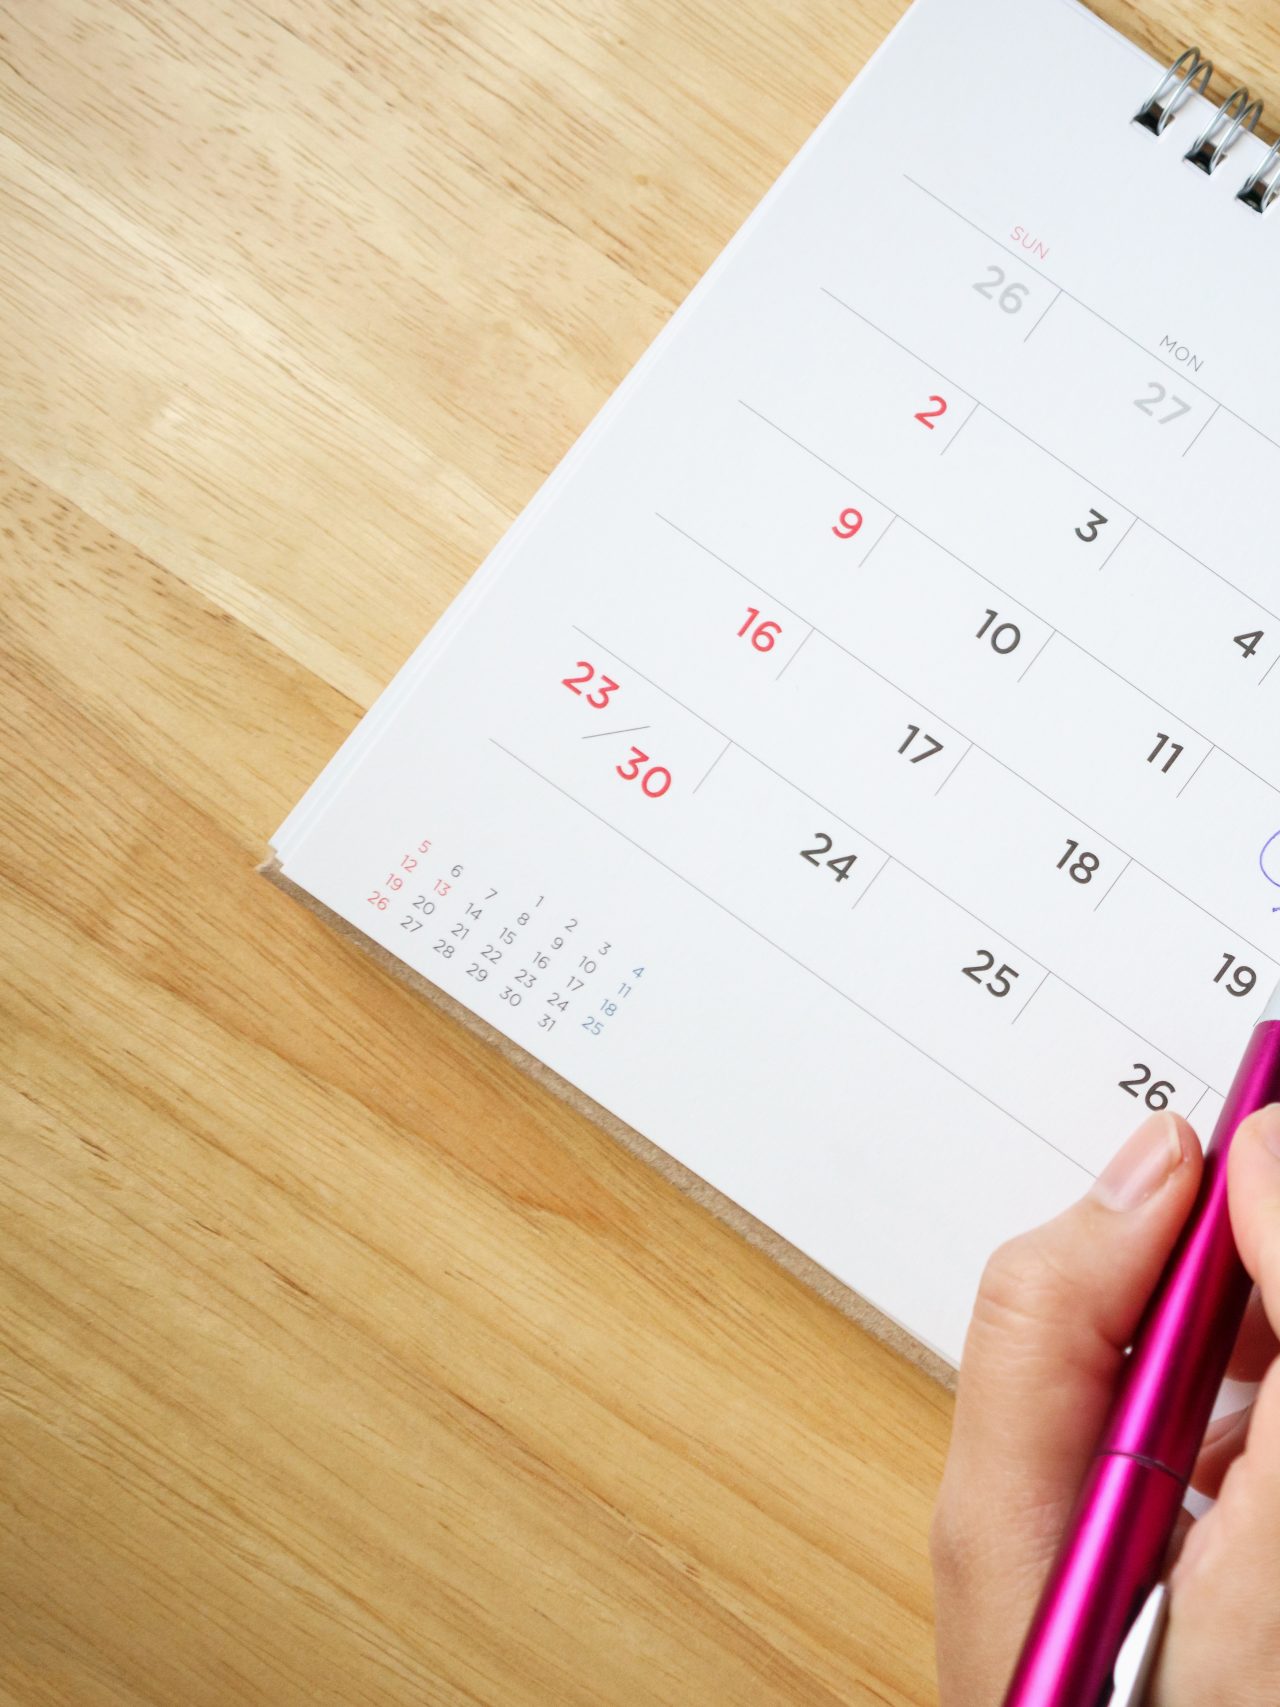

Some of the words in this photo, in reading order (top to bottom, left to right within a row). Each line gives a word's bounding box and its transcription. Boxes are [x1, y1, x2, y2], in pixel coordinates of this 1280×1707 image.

[972, 265, 1029, 314] 26
[1133, 382, 1192, 424] 27
[1009, 225, 1050, 260] SUN
[1159, 334, 1204, 372] MON
[914, 395, 947, 429] 2
[1075, 509, 1108, 542] 3
[1233, 631, 1264, 658] 4
[832, 508, 863, 539] 9
[976, 609, 1020, 654] 10
[1147, 733, 1184, 773] 11
[616, 746, 671, 798] 30
[737, 607, 782, 652] 16
[898, 725, 944, 763] 17
[1057, 839, 1099, 884] 18
[1213, 953, 1256, 997] 19
[367, 891, 389, 910] 26
[400, 915, 423, 932] 27
[433, 939, 455, 958] 28
[466, 963, 488, 982] 29
[499, 986, 522, 1006] 30
[538, 1014, 556, 1031] 31
[386, 873, 403, 891] 19
[412, 895, 435, 915] 20
[451, 923, 469, 940] 21
[480, 945, 502, 964] 22
[514, 969, 537, 988] 23
[547, 992, 569, 1012] 24
[581, 1016, 604, 1035] 25
[401, 855, 418, 873] 12
[434, 879, 451, 896] 13
[465, 903, 483, 920] 14
[499, 927, 517, 944] 15
[533, 952, 550, 969] 16
[567, 976, 584, 991] 17
[600, 999, 617, 1016] 18
[418, 840, 431, 853] 5
[451, 865, 463, 877] 6
[485, 888, 498, 900] 7
[517, 913, 530, 925] 8
[551, 937, 563, 949] 9
[579, 956, 596, 973] 10
[618, 983, 631, 998] 11
[536, 896, 544, 907] 1
[565, 919, 578, 932] 2
[598, 942, 611, 955] 3
[632, 968, 644, 978] 4
[562, 661, 620, 709] 23
[800, 833, 857, 882] 24
[962, 950, 1019, 997] 25
[1118, 1064, 1175, 1111] 26
